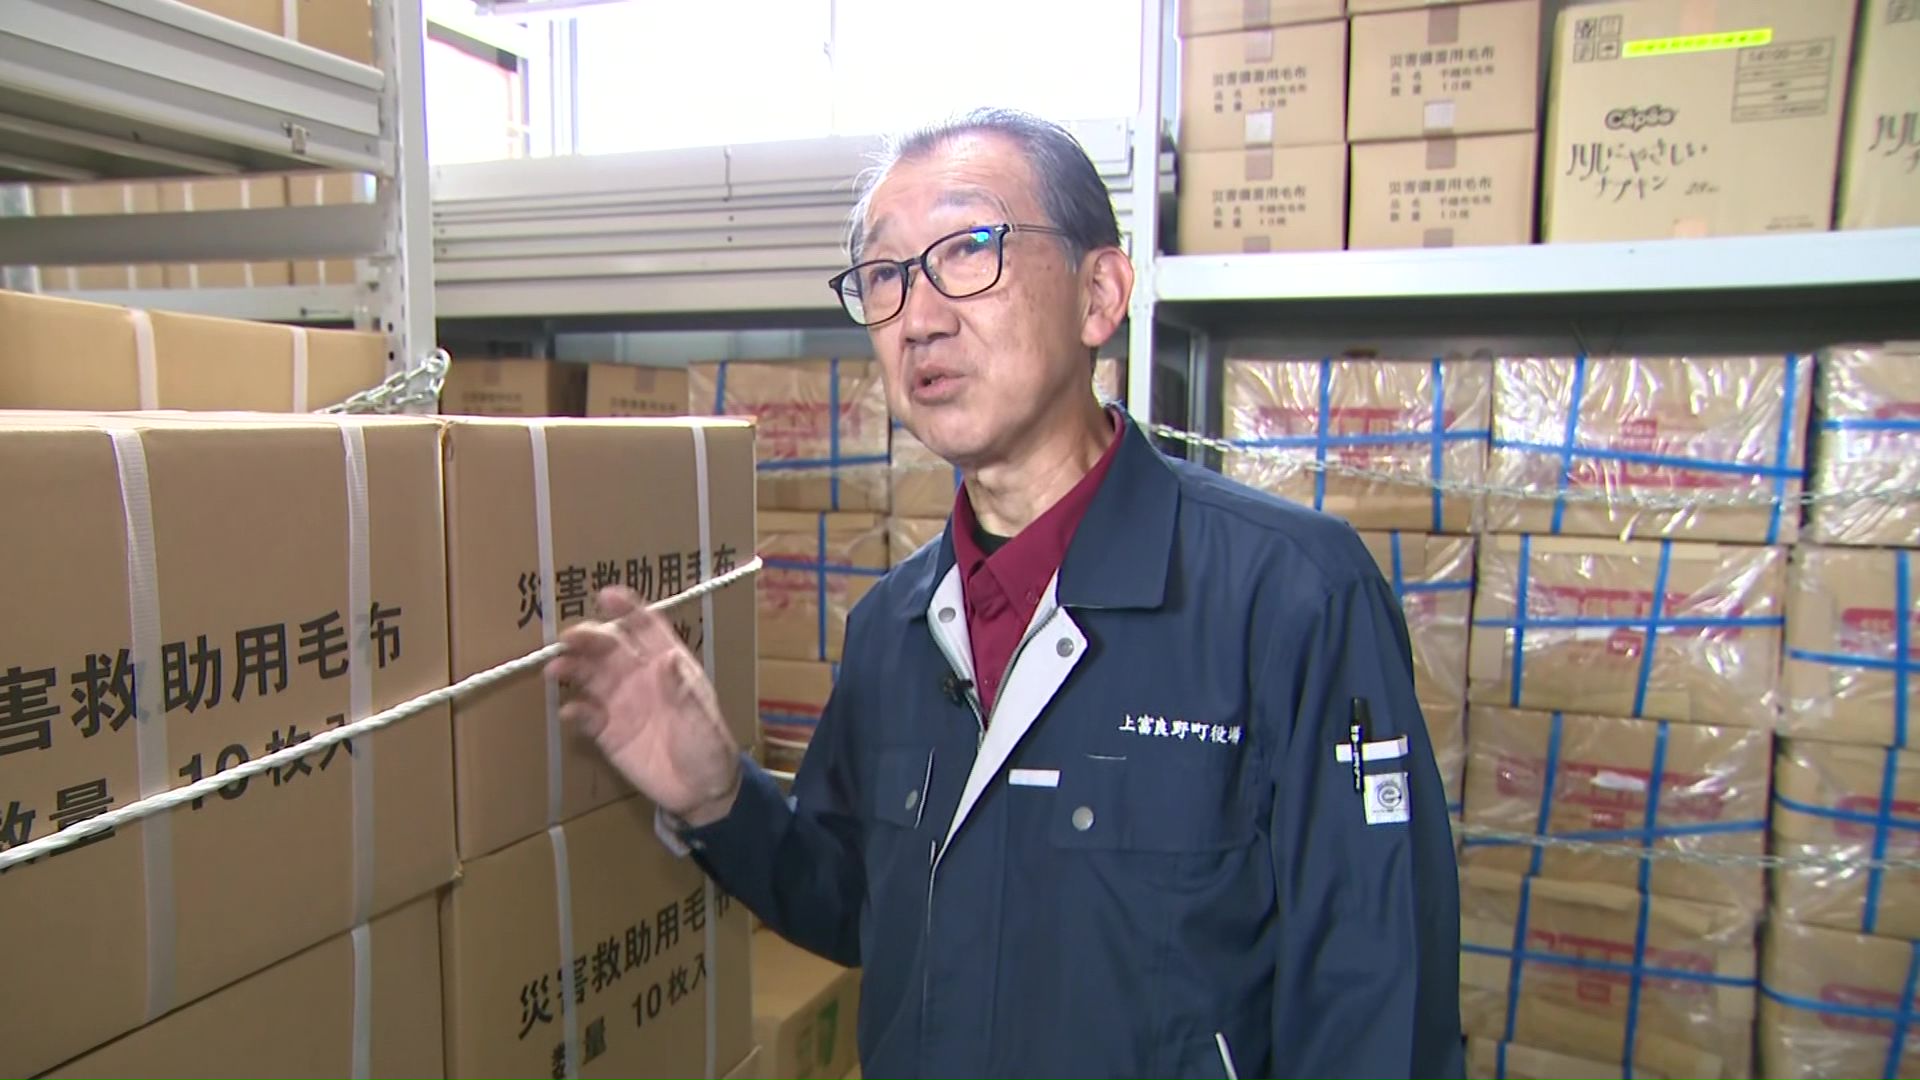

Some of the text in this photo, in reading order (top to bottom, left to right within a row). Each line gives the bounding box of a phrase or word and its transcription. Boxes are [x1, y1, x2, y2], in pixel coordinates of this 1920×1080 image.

[1565, 138, 1708, 181] 肌にやさしい
[1118, 713, 1241, 745] 上富良野町役場
[632, 952, 707, 1029] 10枚入
